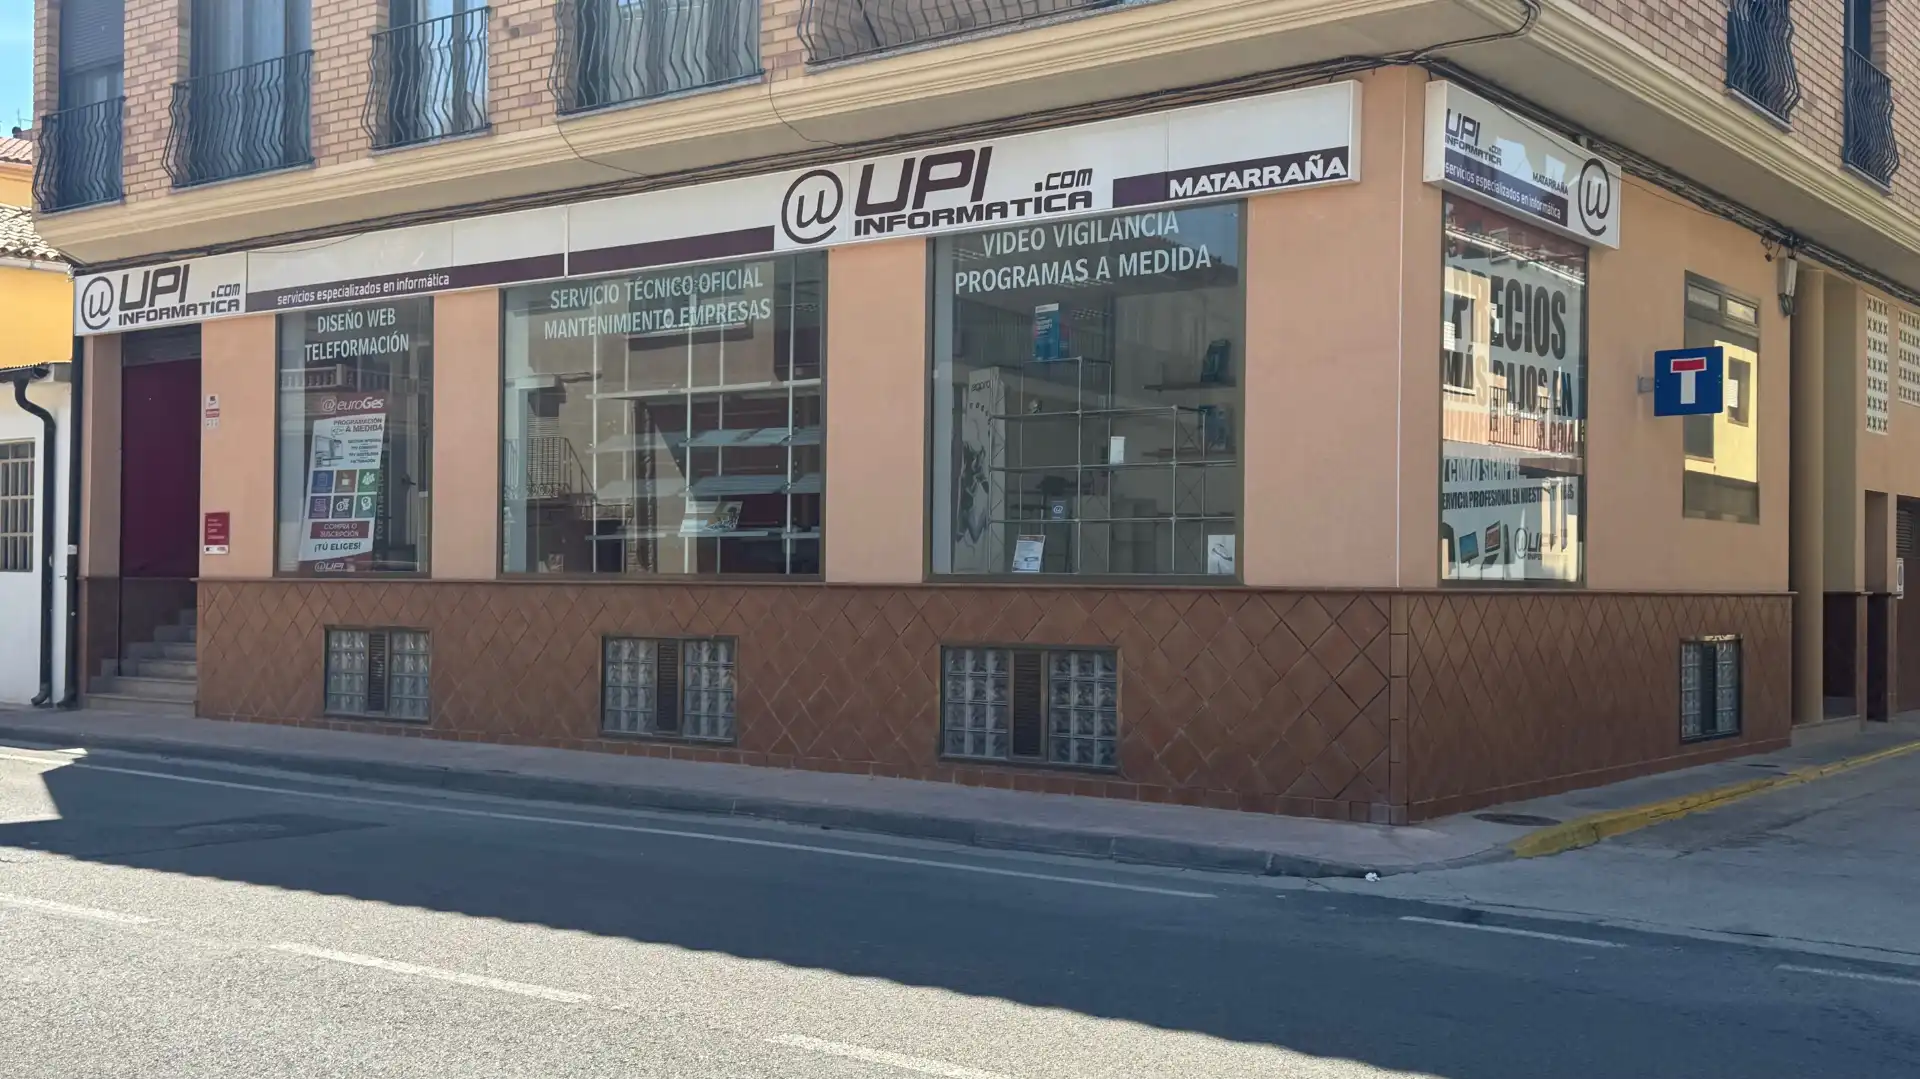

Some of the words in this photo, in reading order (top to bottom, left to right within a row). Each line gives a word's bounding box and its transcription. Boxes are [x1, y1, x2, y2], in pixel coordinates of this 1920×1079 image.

[1445, 108, 1480, 146] UPI
[1445, 135, 1502, 166] INFORMATICA
[854, 145, 994, 217] UPI
[1169, 153, 1347, 199] MATARRAÑA
[1445, 162, 1475, 184] servicios
[1475, 174, 1521, 203] especializados
[1521, 194, 1529, 206] en
[1529, 194, 1561, 219] informática
[1532, 172, 1568, 196] MATARRAÑA
[854, 190, 1093, 236] INFORMATICA
[982, 227, 1046, 259] VIDEO
[1052, 210, 1180, 248] VIGILANCIA
[119, 264, 190, 311] UPI
[277, 290, 315, 306] servicios
[317, 281, 381, 302] especializados
[384, 281, 395, 293] en
[396, 273, 450, 291] informática
[550, 283, 620, 310] SERVICIO
[624, 275, 693, 301] TÉCNICO
[699, 266, 764, 294] OFICIAL
[955, 258, 1088, 295] PROGRAMAS
[1096, 255, 1111, 281] A
[1119, 244, 1212, 278] MEDIDA
[118, 298, 241, 326] INFORMATICA
[317, 309, 363, 334] DISEÑO
[367, 307, 396, 328] WEB
[544, 308, 675, 340] MANTENIMIENTO
[680, 297, 772, 327] EMPRESAS
[305, 330, 409, 362] TELEFORMACIÓN
[352, 424, 382, 432] MEDIDA
